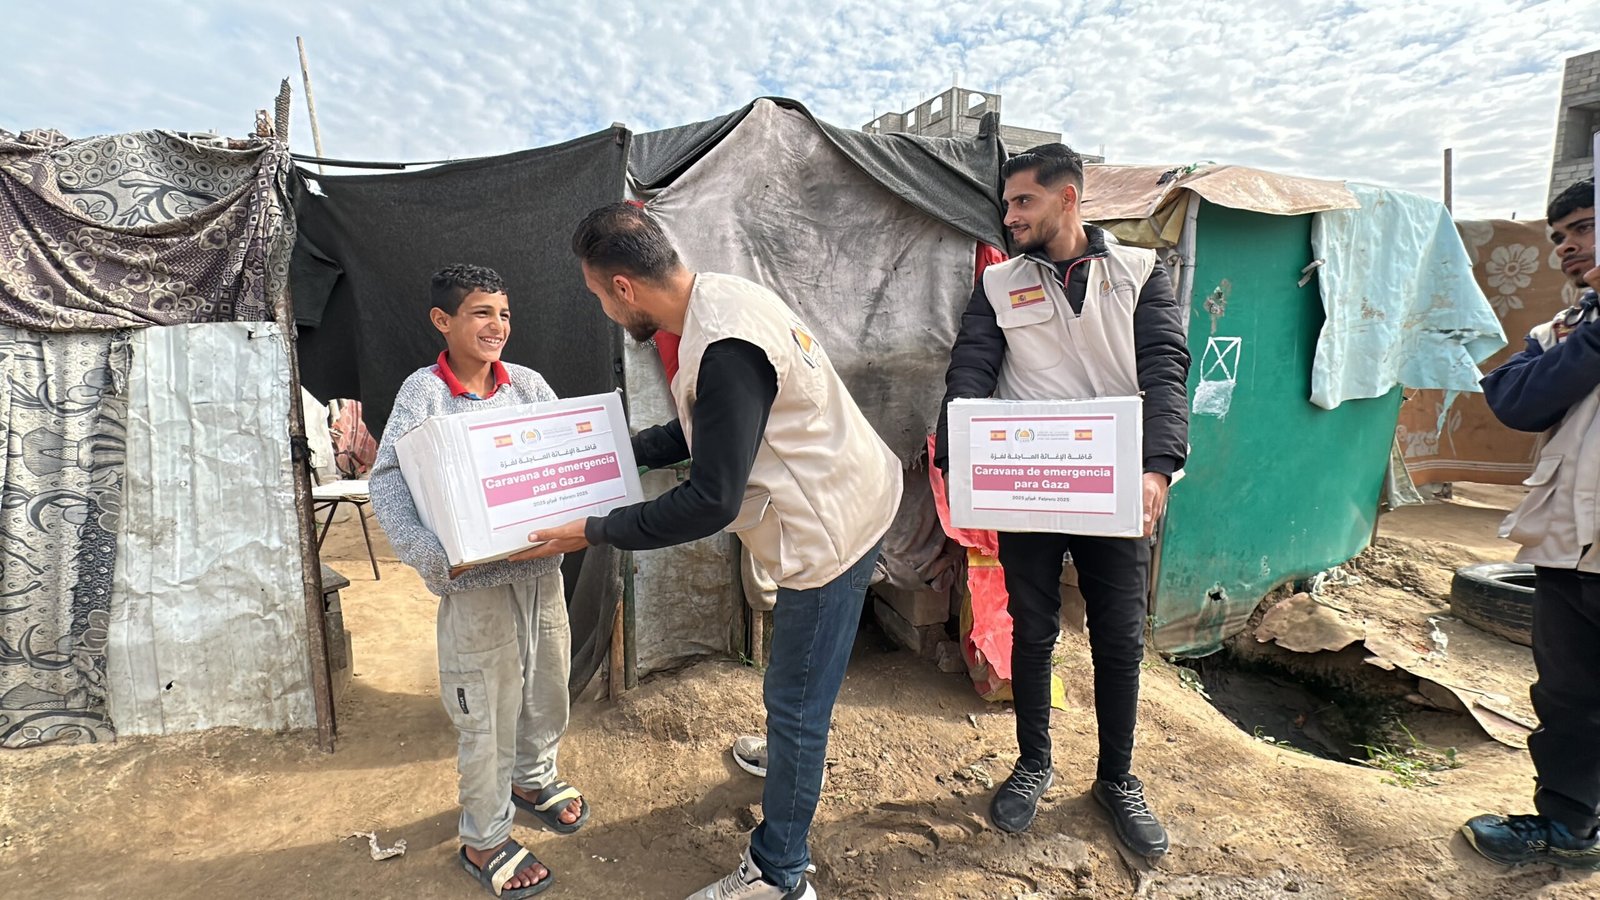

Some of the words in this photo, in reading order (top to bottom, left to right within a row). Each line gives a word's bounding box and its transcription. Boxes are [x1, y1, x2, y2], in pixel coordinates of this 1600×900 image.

[1040, 453, 1066, 461] الإغاثة
[485, 472, 540, 489] Caravana
[542, 467, 556, 477] de
[558, 455, 615, 474] emergencia
[974, 466, 1024, 476] Caravana
[1026, 467, 1040, 476] de
[1043, 467, 1111, 479] emergencia
[532, 481, 557, 495] para
[559, 474, 586, 487] Gaza
[1014, 480, 1039, 490] para
[1041, 480, 1070, 489] Gaza
